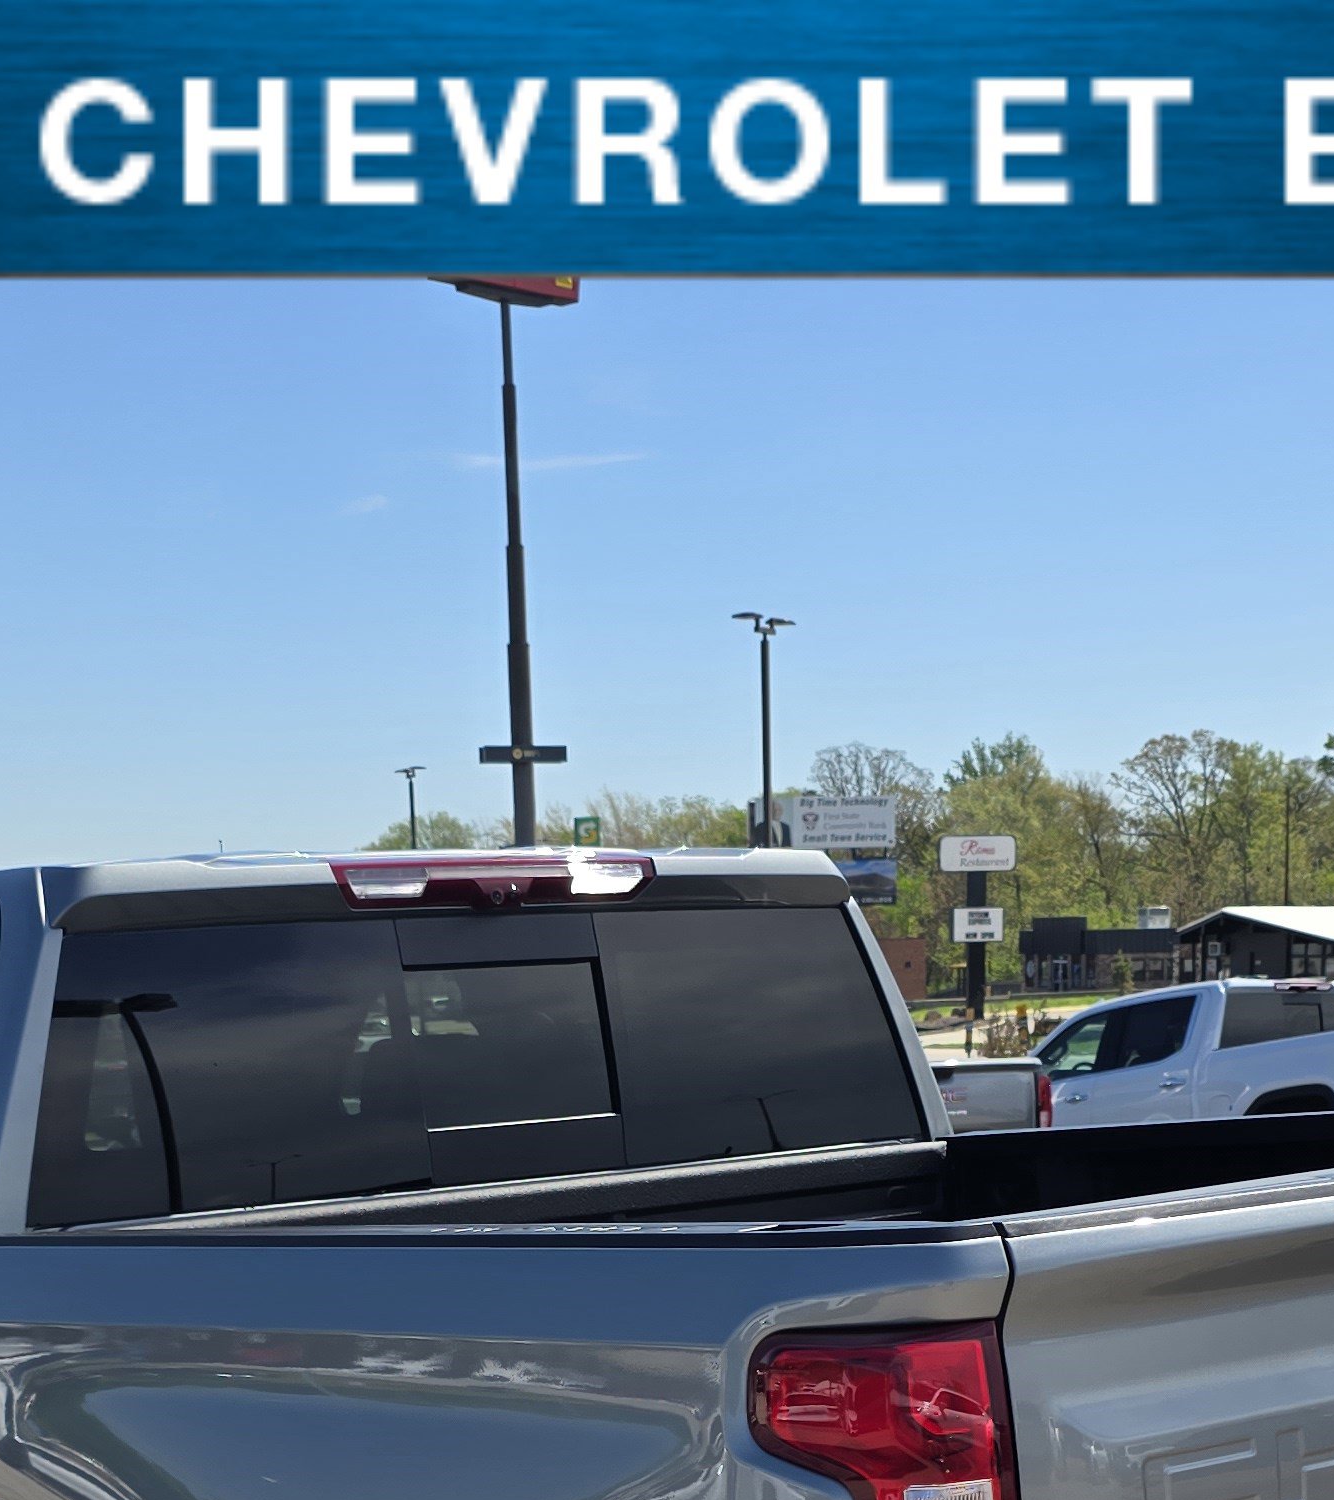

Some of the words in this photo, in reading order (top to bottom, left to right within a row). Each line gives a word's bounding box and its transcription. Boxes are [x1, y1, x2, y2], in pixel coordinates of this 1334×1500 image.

[799, 798, 814, 808] Big
[817, 798, 837, 807] Time
[840, 798, 888, 808] Technology
[802, 833, 828, 843] Small
[830, 833, 852, 842] Town
[854, 832, 887, 842] Service
[959, 858, 1009, 868] Restaurant
